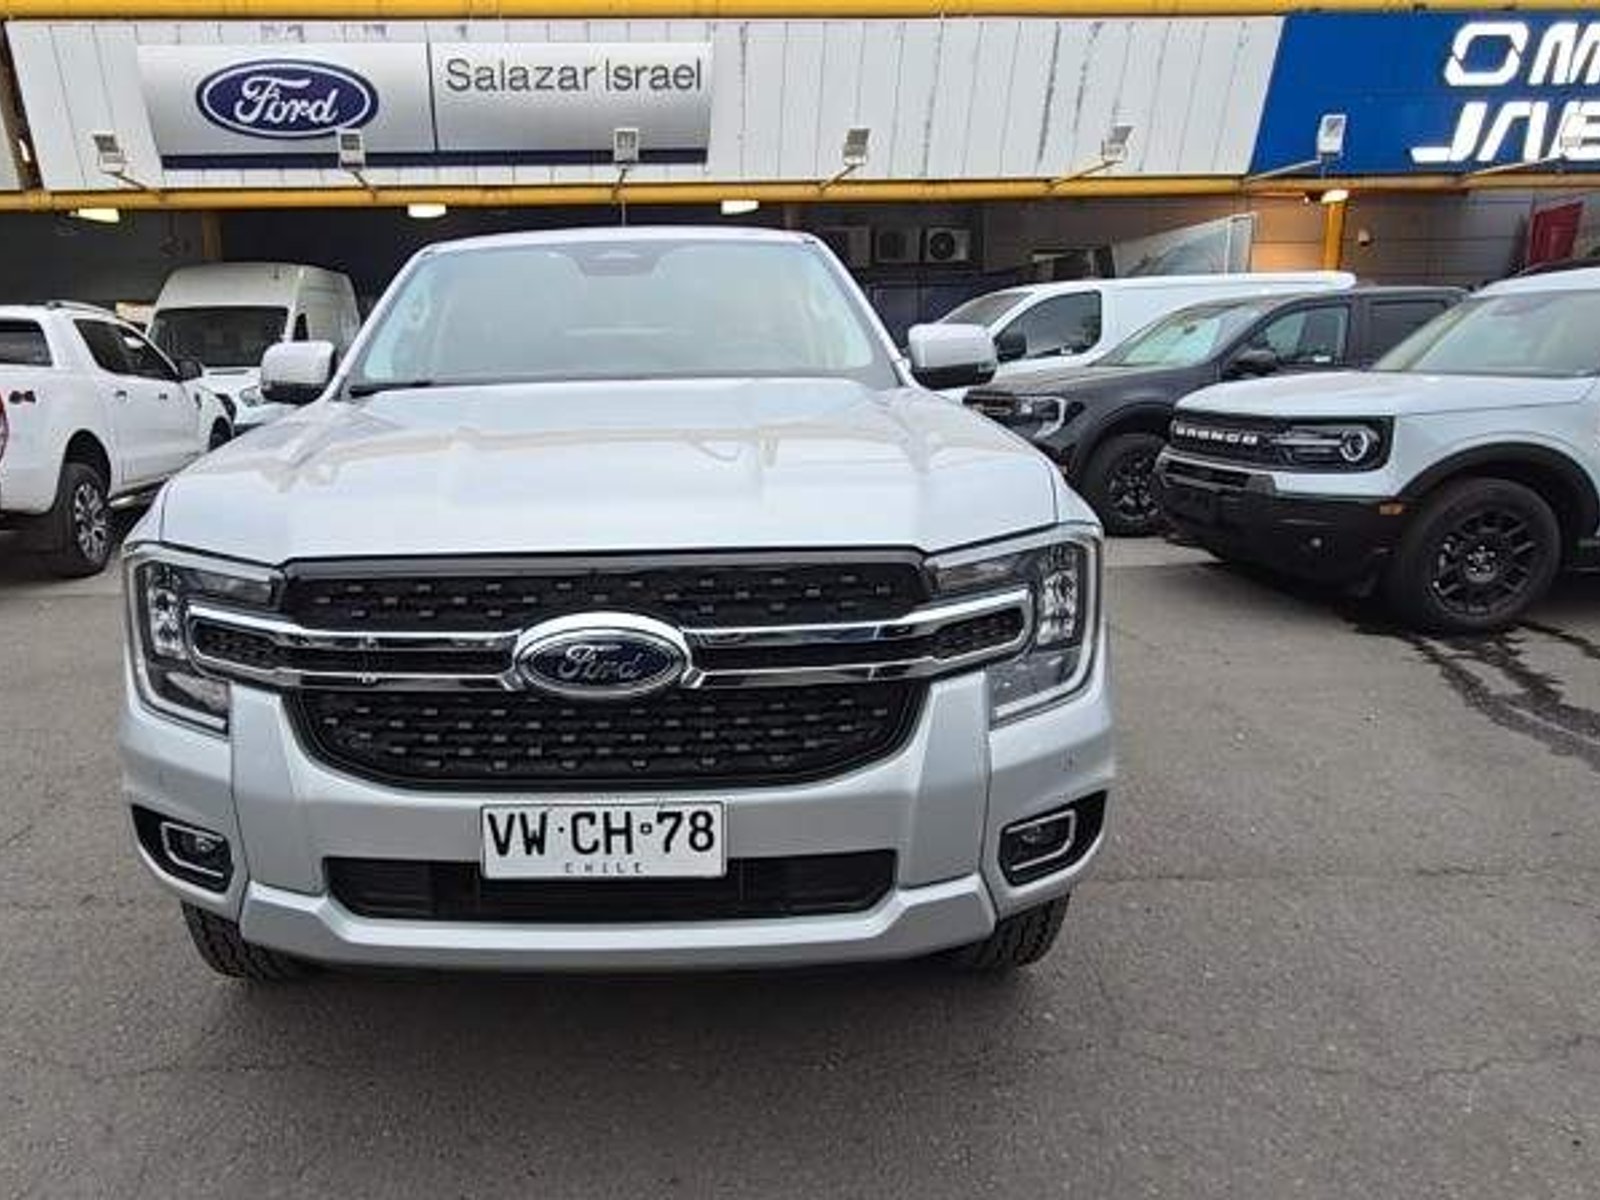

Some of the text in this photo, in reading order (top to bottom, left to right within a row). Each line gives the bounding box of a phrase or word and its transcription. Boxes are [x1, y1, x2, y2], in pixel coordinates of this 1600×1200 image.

[446, 57, 701, 92] Salazar Israel
[234, 75, 338, 125] Ford
[557, 644, 643, 679] Ford
[564, 861, 644, 874] CHILE
